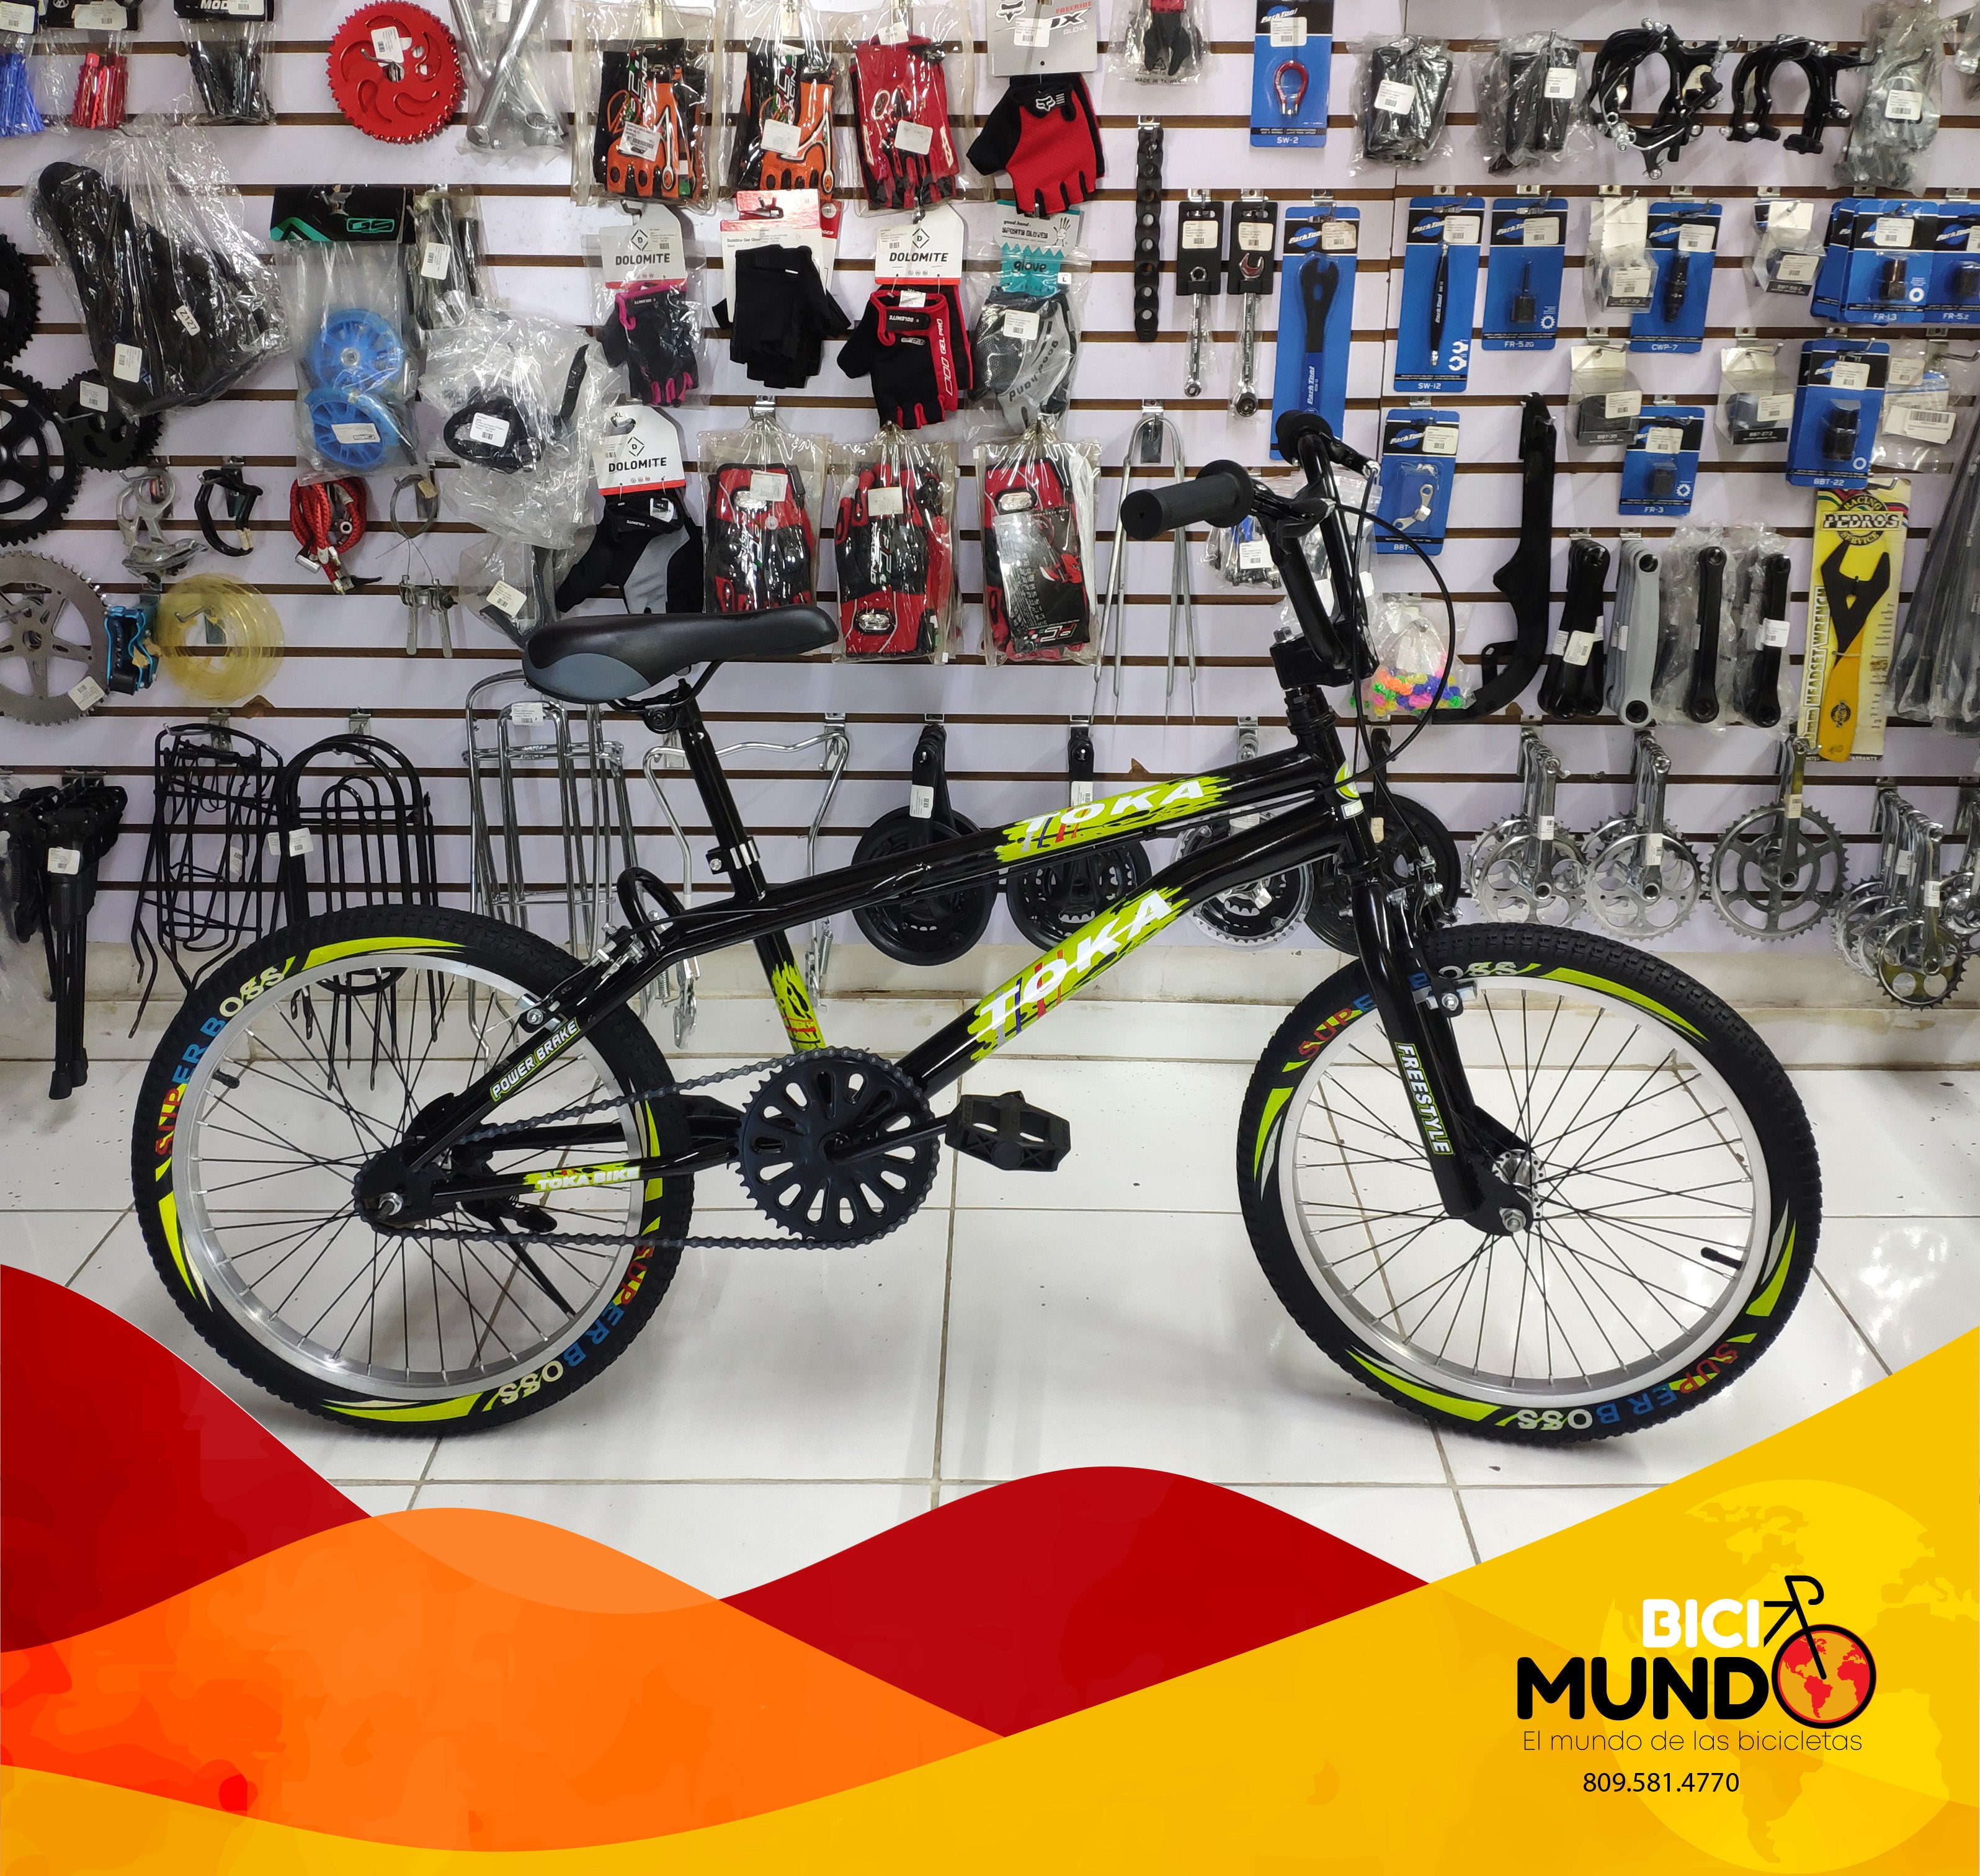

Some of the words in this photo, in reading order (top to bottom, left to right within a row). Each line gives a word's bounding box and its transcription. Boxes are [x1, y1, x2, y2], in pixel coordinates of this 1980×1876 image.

[1063, 25, 1089, 35] GLOVE
[1277, 136, 1298, 145] SW-2
[1002, 227, 1025, 236] SPORTS
[1026, 230, 1048, 239] GLOVES
[615, 252, 671, 266] DOLOMITE
[889, 252, 949, 262] DOLOMITE
[1014, 259, 1047, 272] glove
[179, 308, 197, 330] Z127
[609, 457, 667, 473] DOLOMITE
[1814, 478, 1845, 486] BBT-22
[1844, 496, 1883, 510] RACING
[1840, 531, 1880, 545] SERVICE
[1813, 587, 1828, 646] WRENCH
[1806, 649, 1825, 705] HEADSET
[1021, 779, 1205, 834] TOKA
[979, 891, 1174, 1038] TOKA
[1298, 993, 1377, 1058] SUPE
[155, 1043, 208, 1156] SUPER
[200, 965, 285, 1038] BOSS
[492, 1056, 535, 1098] POWER
[536, 1020, 578, 1061] BRAKE
[1397, 1044, 1451, 1153] FREESTYLE
[537, 1174, 589, 1190] TOKA
[594, 1166, 640, 1184] BIKE
[498, 1342, 587, 1405] BOSS
[1626, 1342, 1738, 1414] SUPER
[1516, 1403, 1621, 1431] BOSS
